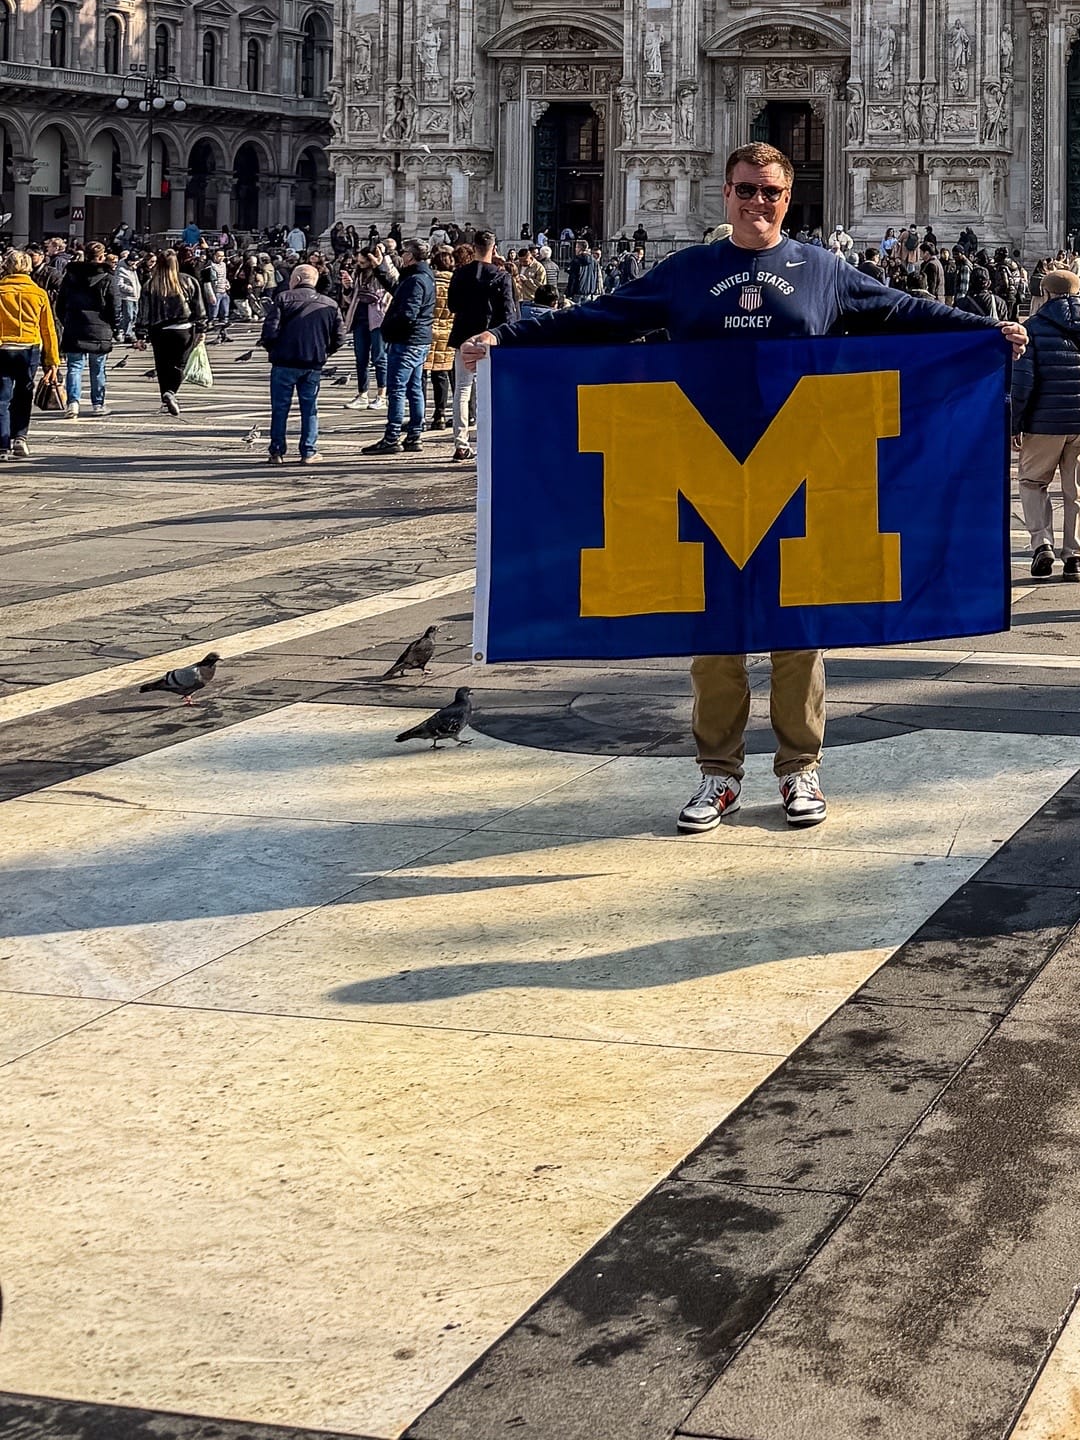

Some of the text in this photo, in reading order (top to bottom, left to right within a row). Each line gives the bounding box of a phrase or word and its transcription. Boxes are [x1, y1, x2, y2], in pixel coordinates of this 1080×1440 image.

[709, 271, 795, 297] UNITED STATES
[724, 315, 772, 329] HOCKEY
[577, 370, 902, 618] M
